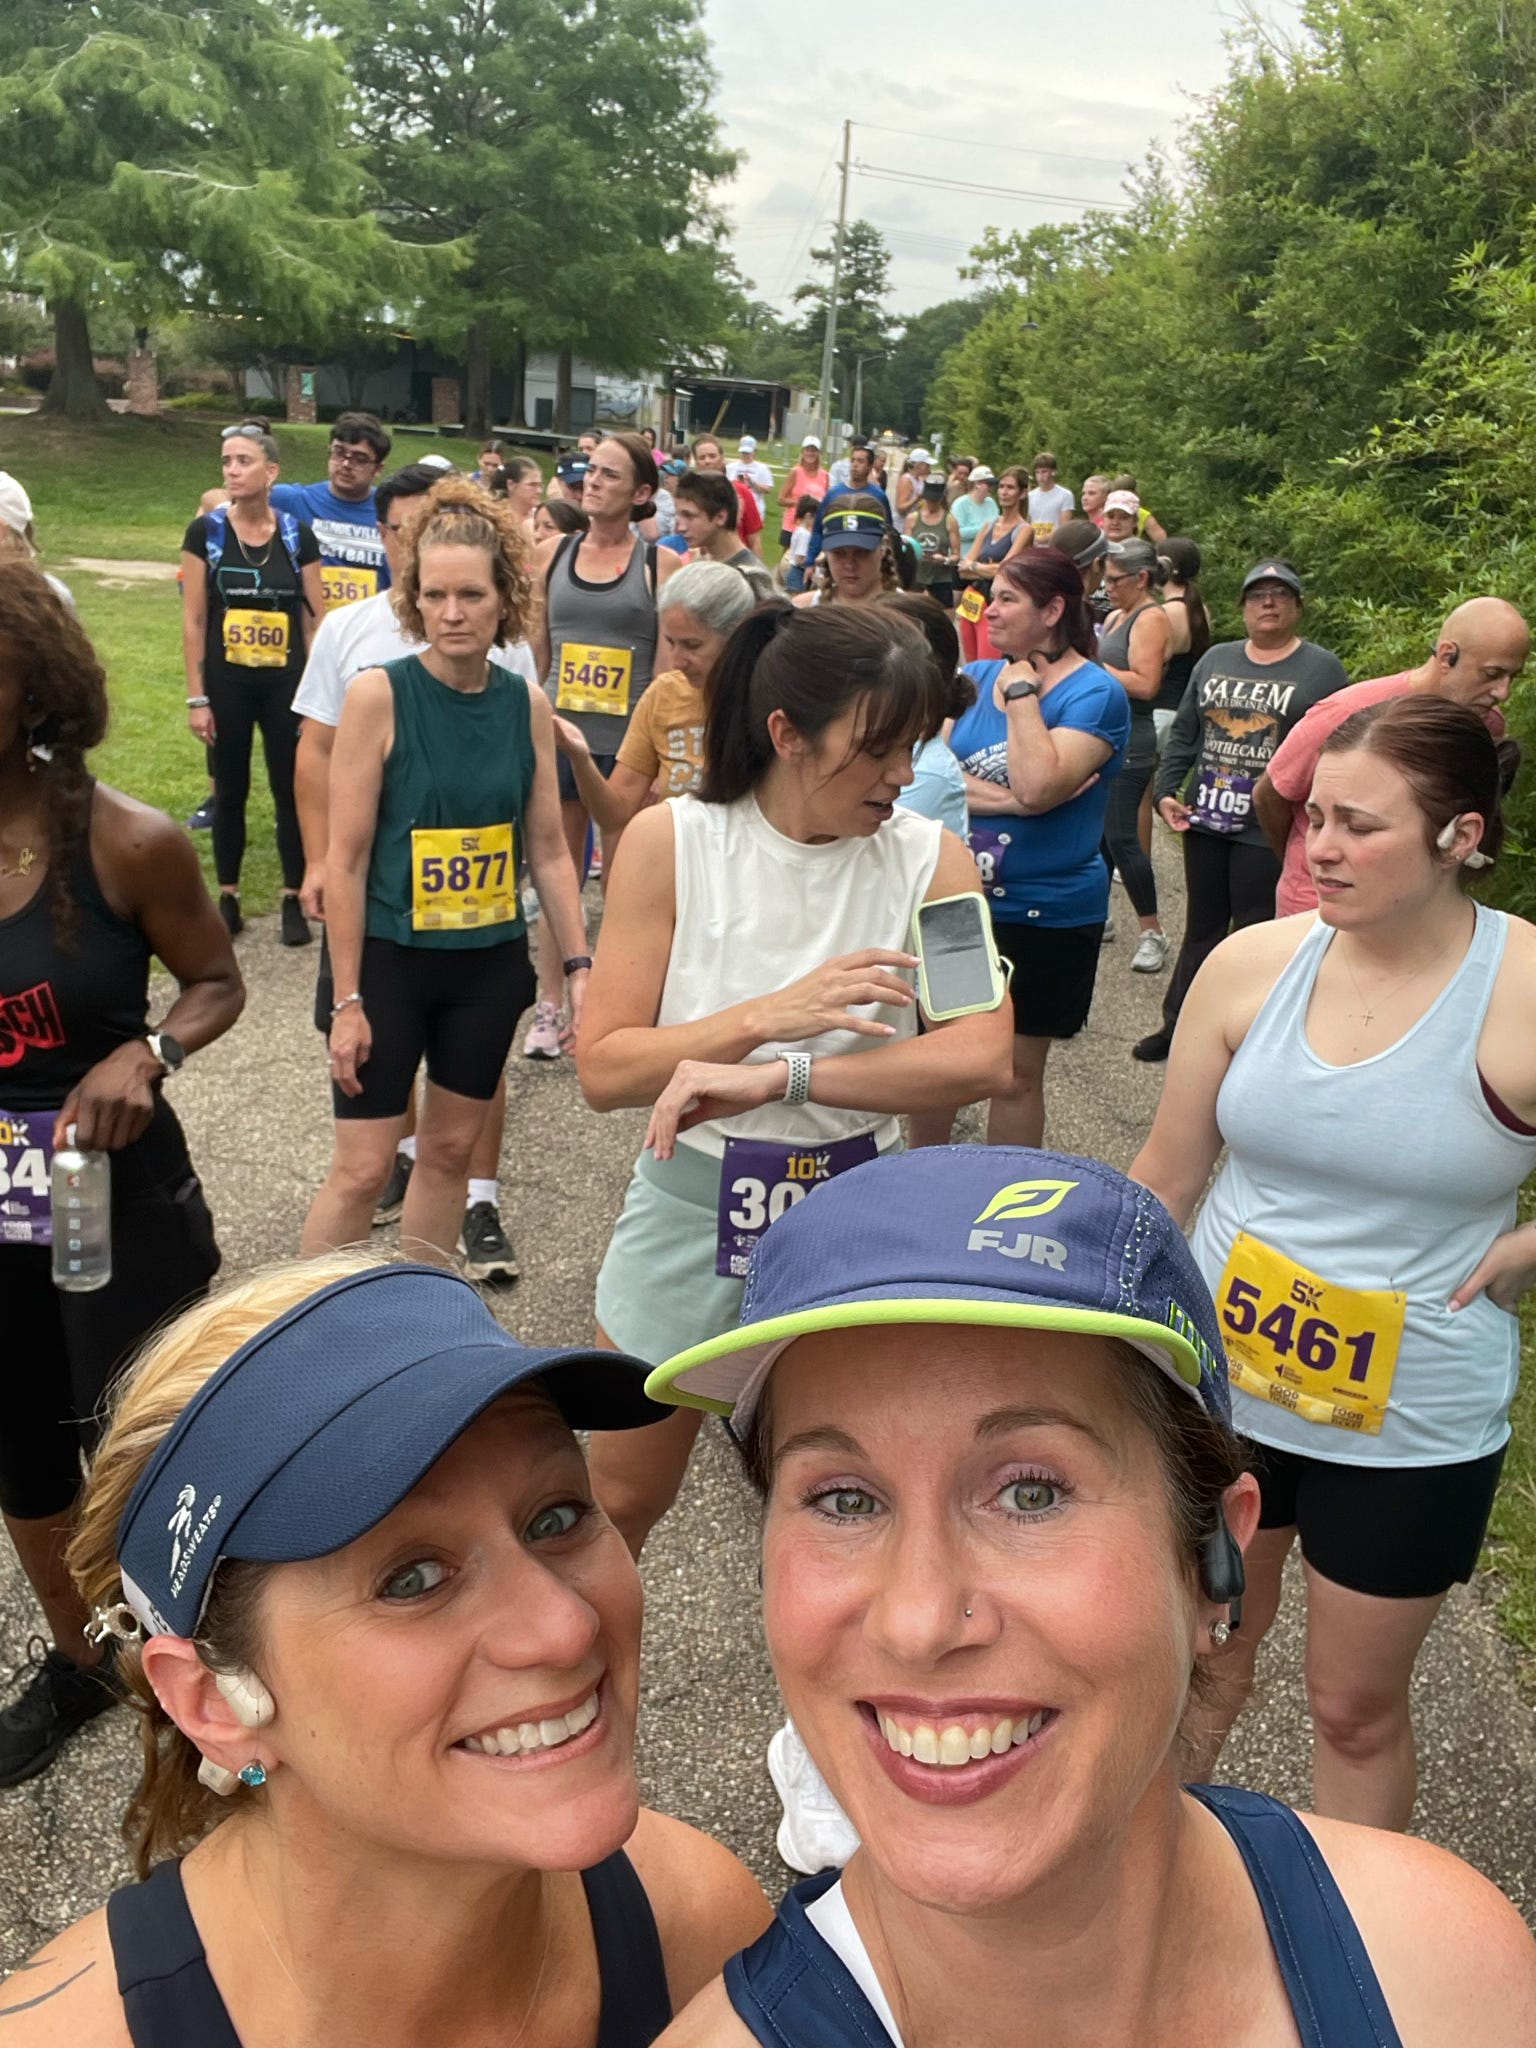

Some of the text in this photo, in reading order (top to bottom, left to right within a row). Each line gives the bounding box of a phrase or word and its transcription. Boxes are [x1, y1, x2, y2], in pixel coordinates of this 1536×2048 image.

[318, 543, 383, 566] OOTBALL
[321, 581, 369, 600] 5361
[228, 624, 284, 647] 5360
[562, 660, 625, 690] 5467
[1200, 677, 1296, 717] SALEM
[1214, 697, 1269, 714] MEDICINES
[667, 726, 705, 760] ST
[964, 748, 987, 769] TRIBE
[1213, 775, 1233, 791] 10K
[1196, 783, 1252, 816] 3105
[461, 836, 480, 852] 5K
[421, 850, 508, 893] 5877
[972, 850, 995, 882] 8
[0, 1121, 30, 1147] 0K
[785, 1154, 831, 1180] 10K
[728, 1176, 826, 1230] 30
[729, 1254, 750, 1265] FOO
[967, 1229, 1068, 1272] FJR
[1289, 1277, 1325, 1313] 5K
[1222, 1275, 1376, 1384] 5461
[1269, 1383, 1300, 1401] FOOD
[170, 1502, 219, 1600] HEADSWEATS
